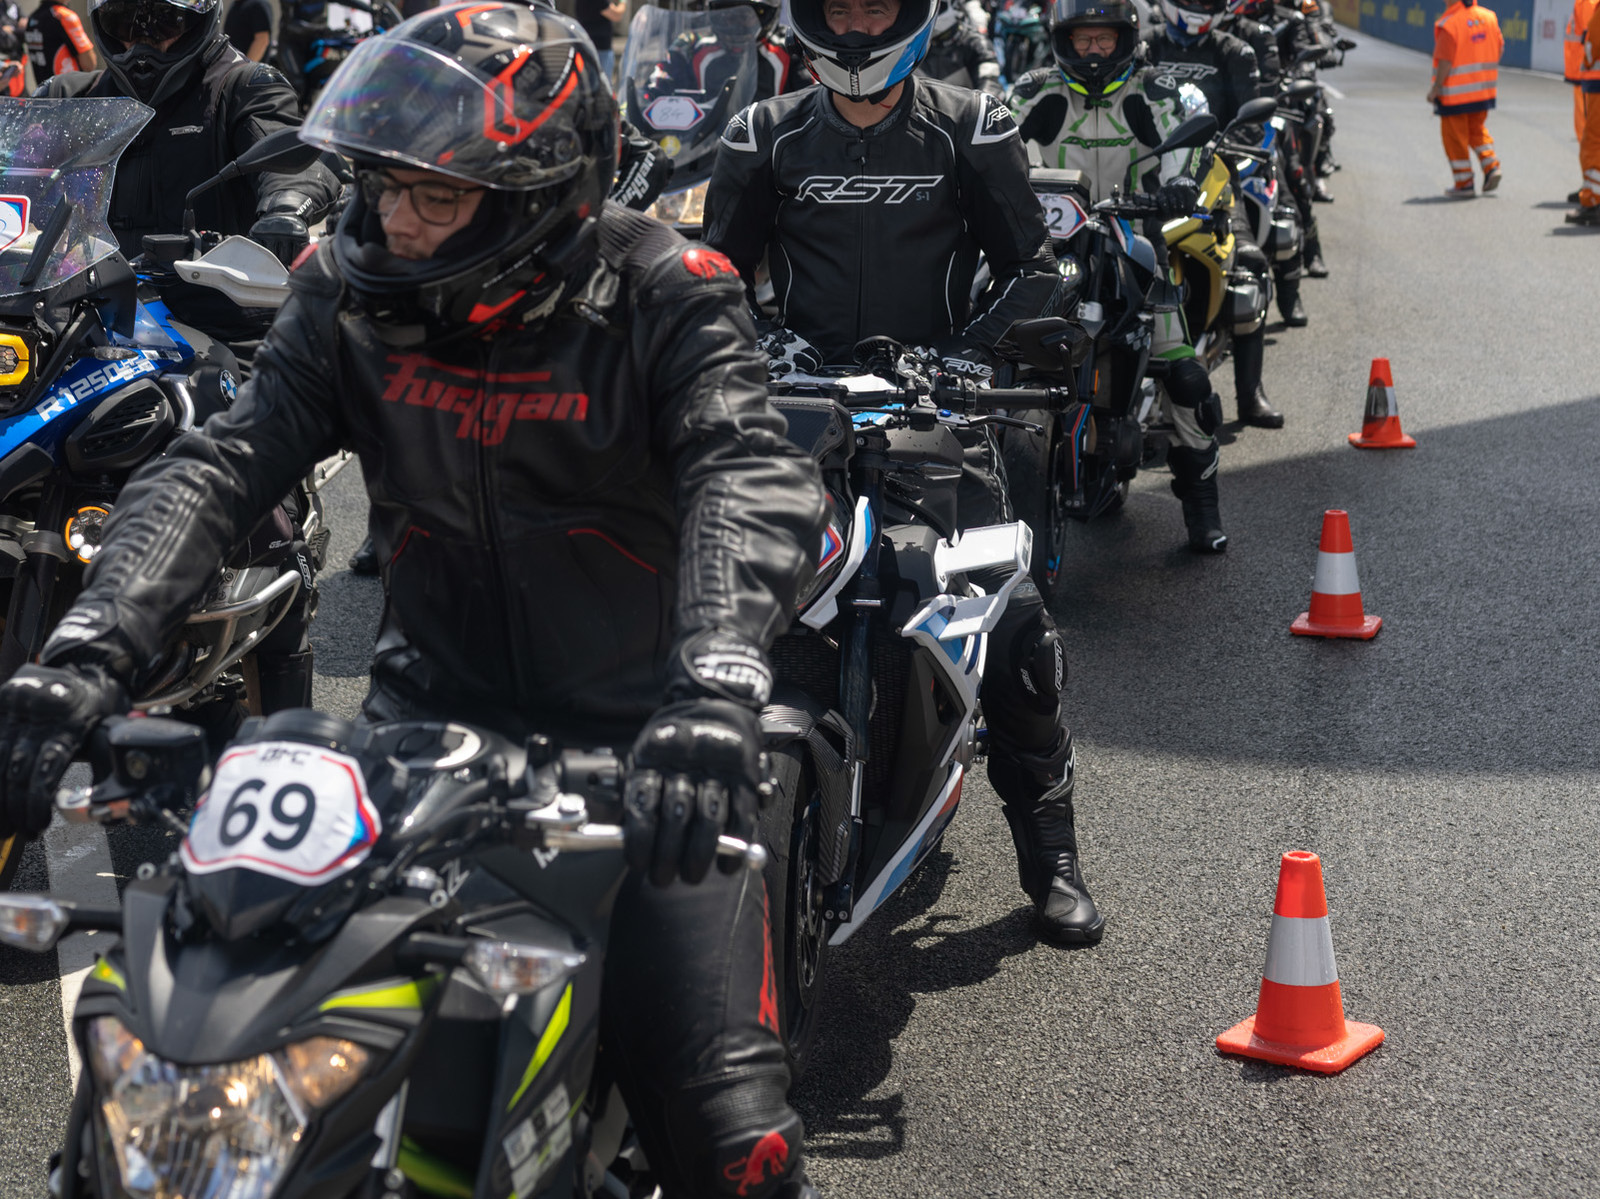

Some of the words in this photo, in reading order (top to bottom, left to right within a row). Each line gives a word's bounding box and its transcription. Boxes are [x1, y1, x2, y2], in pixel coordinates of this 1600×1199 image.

[850, 73, 859, 95] BMW
[985, 104, 1013, 131] RS
[795, 175, 944, 204] RST
[916, 191, 930, 201] S-1
[942, 357, 993, 377] FIVE
[1053, 639, 1063, 690] RST
[219, 779, 316, 852] 69
